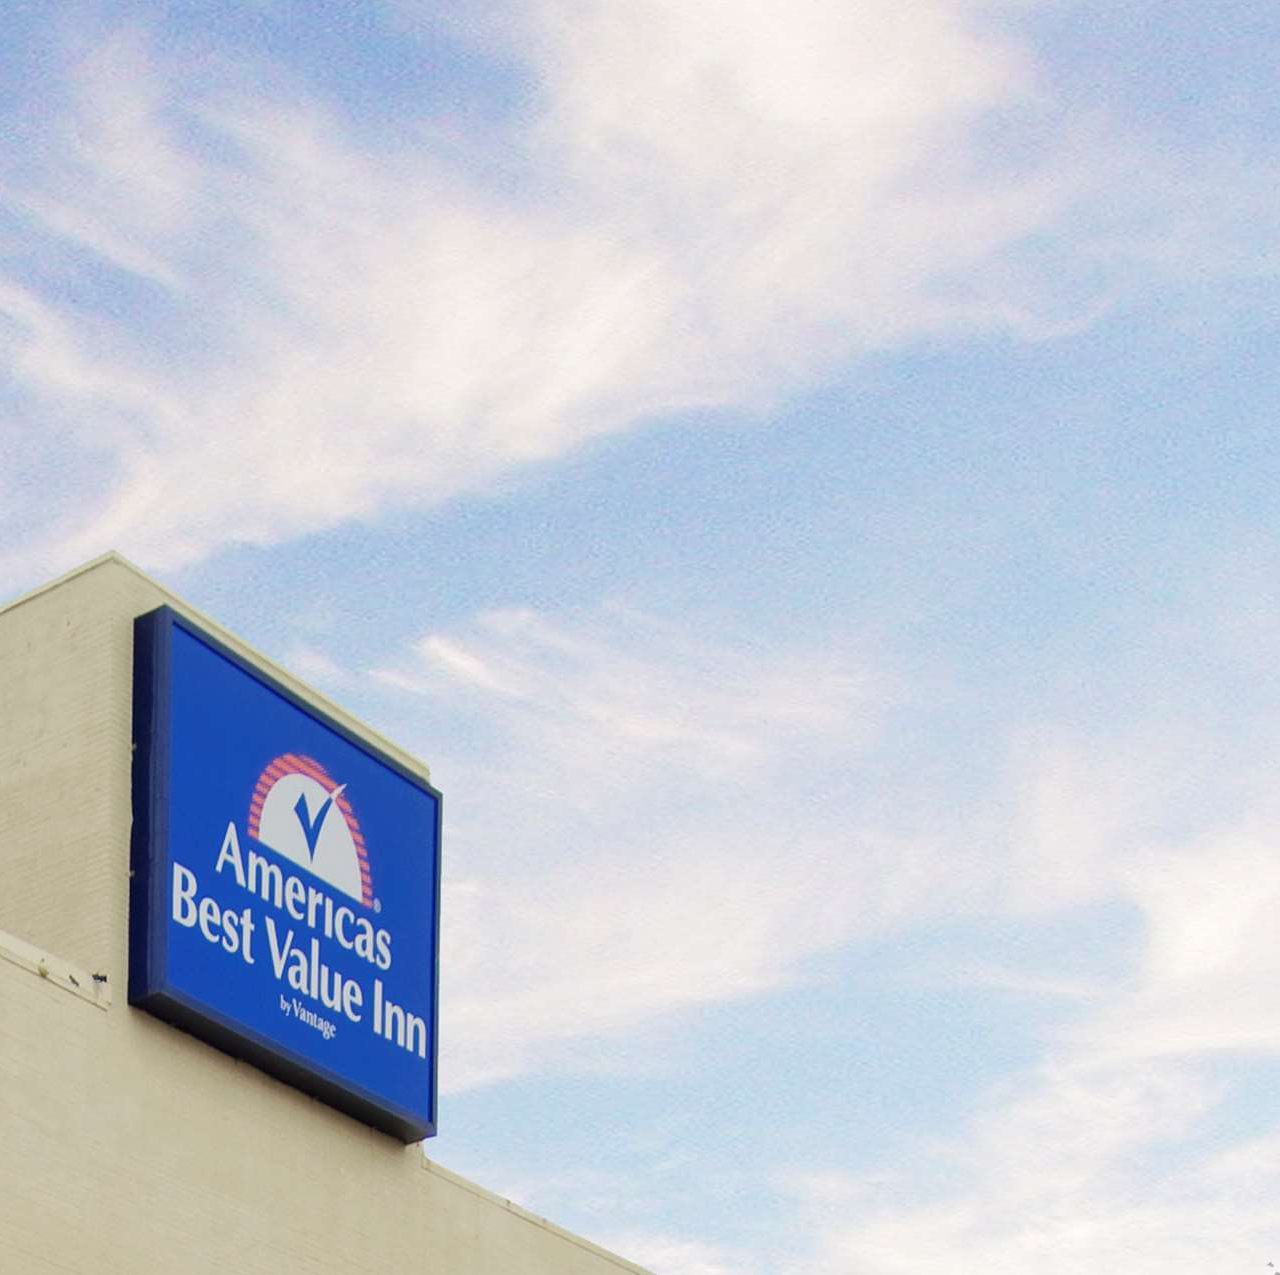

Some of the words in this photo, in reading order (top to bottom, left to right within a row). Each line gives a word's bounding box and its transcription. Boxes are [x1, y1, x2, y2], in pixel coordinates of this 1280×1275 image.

[172, 861, 255, 964] Best
[265, 915, 363, 1023] Value
[372, 978, 427, 1059] Inn
[215, 820, 392, 970] Americas
[280, 993, 292, 1016] by
[292, 998, 337, 1040] Vantage
